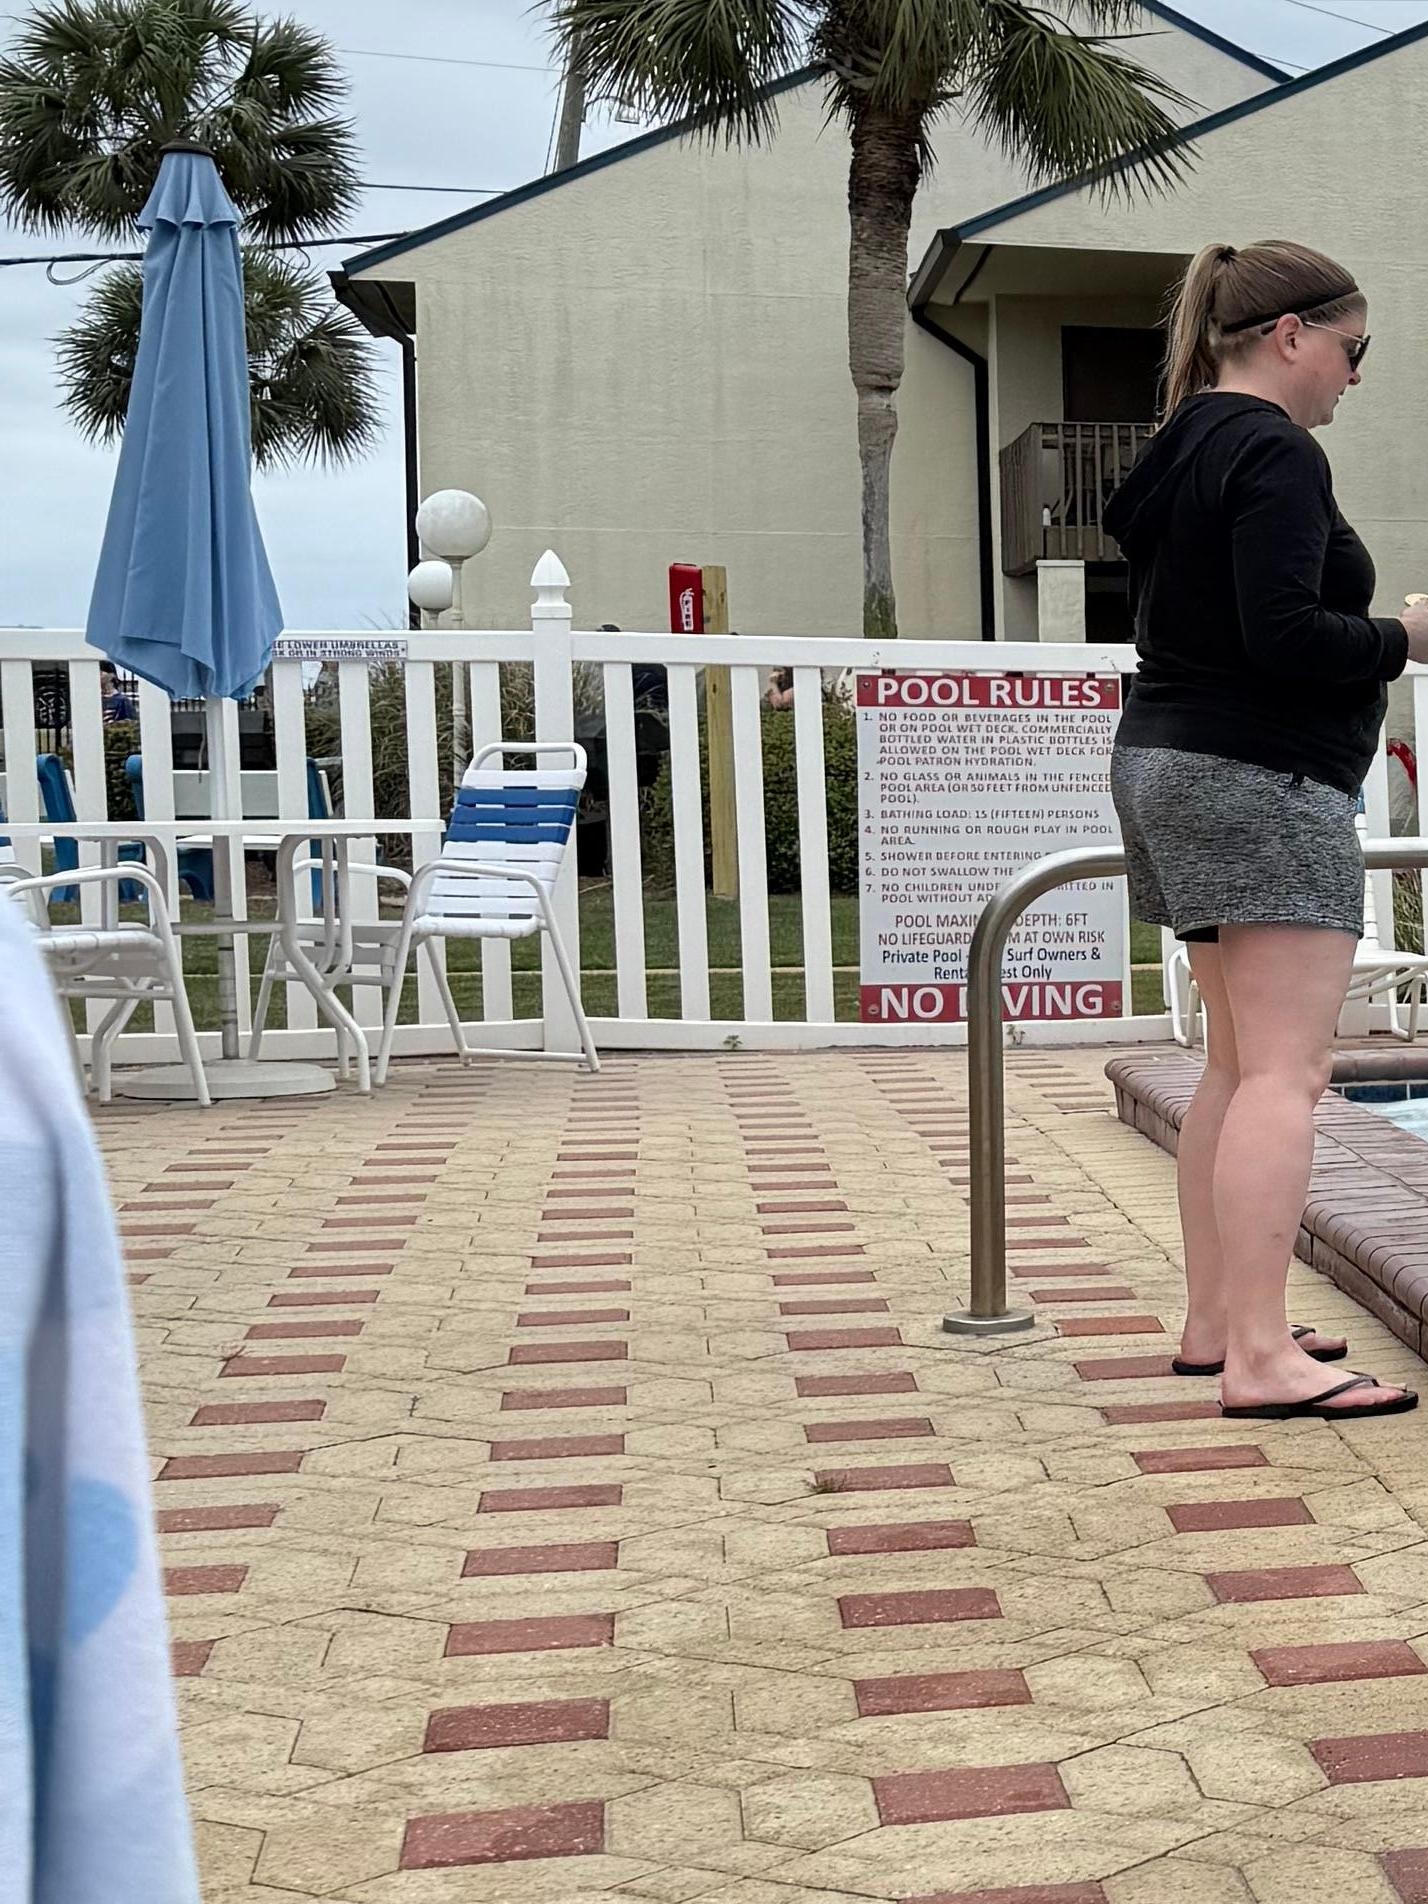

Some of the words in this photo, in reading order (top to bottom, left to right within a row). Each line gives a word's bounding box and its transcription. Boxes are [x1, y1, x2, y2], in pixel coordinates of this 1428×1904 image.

[877, 678, 980, 705] POOL
[990, 679, 1101, 706] RULES
[879, 713, 897, 721] NO
[903, 713, 936, 722] FOOD
[943, 713, 958, 722] OR
[965, 713, 1030, 722] BEVERAGES
[1036, 714, 1048, 722] IN
[1055, 714, 1075, 723] THE
[1081, 714, 1111, 723] POOL
[879, 724, 896, 732] OR
[900, 724, 917, 733] ON
[921, 724, 952, 733] POOL
[957, 724, 981, 733] WET
[1022, 725, 1111, 734] COMMERCIALLY
[879, 735, 931, 744] BOTTLED
[937, 735, 976, 744] WATER
[982, 735, 994, 744] IN
[1000, 736, 1044, 744] PLASTIC
[1050, 736, 1098, 744] BOTTLES
[1102, 736, 1111, 745] IS
[879, 746, 936, 755] ALLOWED
[942, 746, 959, 755] ON
[964, 746, 985, 755] THE
[991, 747, 1021, 755] POOL
[1027, 747, 1051, 755] WET
[1057, 747, 1085, 756] DECK
[1091, 747, 1111, 756] FOR
[880, 757, 911, 766] POOL
[915, 757, 961, 766] PATRON
[965, 757, 1035, 766] HYDRATION.
[864, 772, 873, 781] 2.
[880, 772, 897, 781] NO
[904, 773, 939, 781] GLASS
[945, 773, 962, 781] OR
[967, 773, 1020, 781] ANIMALS
[1026, 773, 1036, 781] IN
[1043, 773, 1063, 782] THE
[880, 783, 911, 792] POOL
[915, 784, 945, 792] AREA
[948, 783, 968, 794] (OR
[971, 784, 983, 792] 50
[986, 784, 1011, 792] FEET
[1015, 784, 1048, 792] FROM
[880, 794, 920, 805] POOL).
[865, 810, 874, 819] 3.
[881, 810, 932, 819] BATHING
[937, 810, 971, 819] LOAD:
[975, 810, 987, 819] 15
[990, 810, 1044, 820] (FIFTEEN)
[1048, 810, 1099, 819] PERSONS
[881, 826, 898, 834] NO
[904, 826, 960, 834] RUNNING
[965, 826, 981, 834] OR
[987, 826, 1028, 834] ROUGH
[1035, 826, 1060, 834] PLAY
[1066, 826, 1077, 834] IN
[1083, 826, 1113, 834] POOL
[865, 852, 875, 861] 5.
[881, 852, 932, 861] SHOWER
[937, 852, 979, 861] BEFORE
[984, 852, 1041, 861] ENTERING
[881, 867, 898, 876] DO
[902, 867, 926, 876] NOT
[931, 867, 989, 876] SWALLOW
[993, 867, 1013, 876] THE
[865, 884, 875, 892] 7.
[882, 883, 898, 892] NO
[904, 883, 962, 892] CHILDREN
[1102, 882, 1113, 891] IN
[882, 894, 913, 903] POOL
[917, 894, 973, 903] WITHOUT
[896, 915, 931, 928] POOL
[1066, 913, 1087, 926] 6FT
[879, 933, 897, 946] NO
[902, 932, 970, 945] LIFEGUARD
[1024, 931, 1038, 943] AT
[1043, 931, 1074, 943] OWN
[1079, 931, 1104, 943] RISK
[883, 950, 928, 963] Private
[933, 949, 962, 962] Pool
[1007, 948, 1034, 961] Surf
[1038, 948, 1087, 961] Owners
[1091, 947, 1101, 960] &
[1022, 965, 1052, 980] Only
[880, 988, 943, 1019] NO
